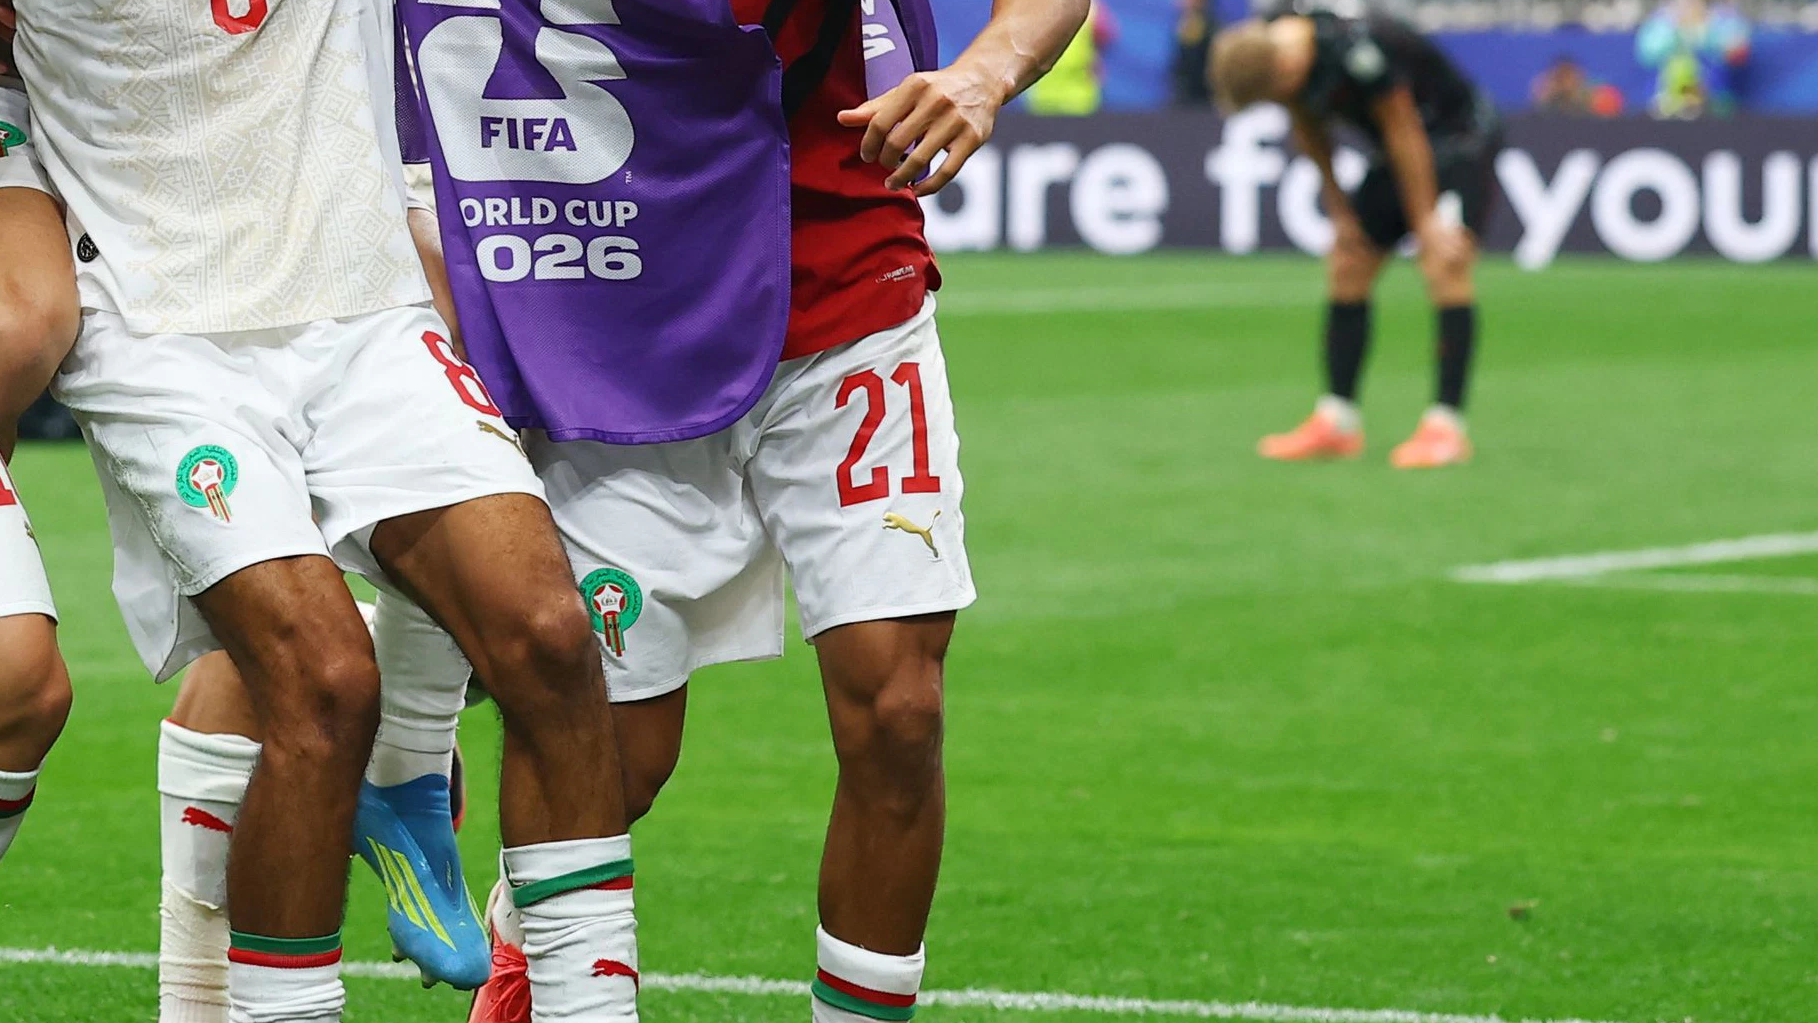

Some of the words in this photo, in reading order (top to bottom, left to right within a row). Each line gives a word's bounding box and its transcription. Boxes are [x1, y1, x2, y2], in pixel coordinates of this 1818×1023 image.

[480, 115, 577, 152] FIFA
[458, 197, 558, 228] ORLD
[564, 199, 639, 228] CUP
[1203, 99, 1374, 257] fo
[1493, 145, 1818, 273] you
[476, 233, 643, 283] 026
[421, 330, 502, 418] 8
[834, 361, 941, 508] 21
